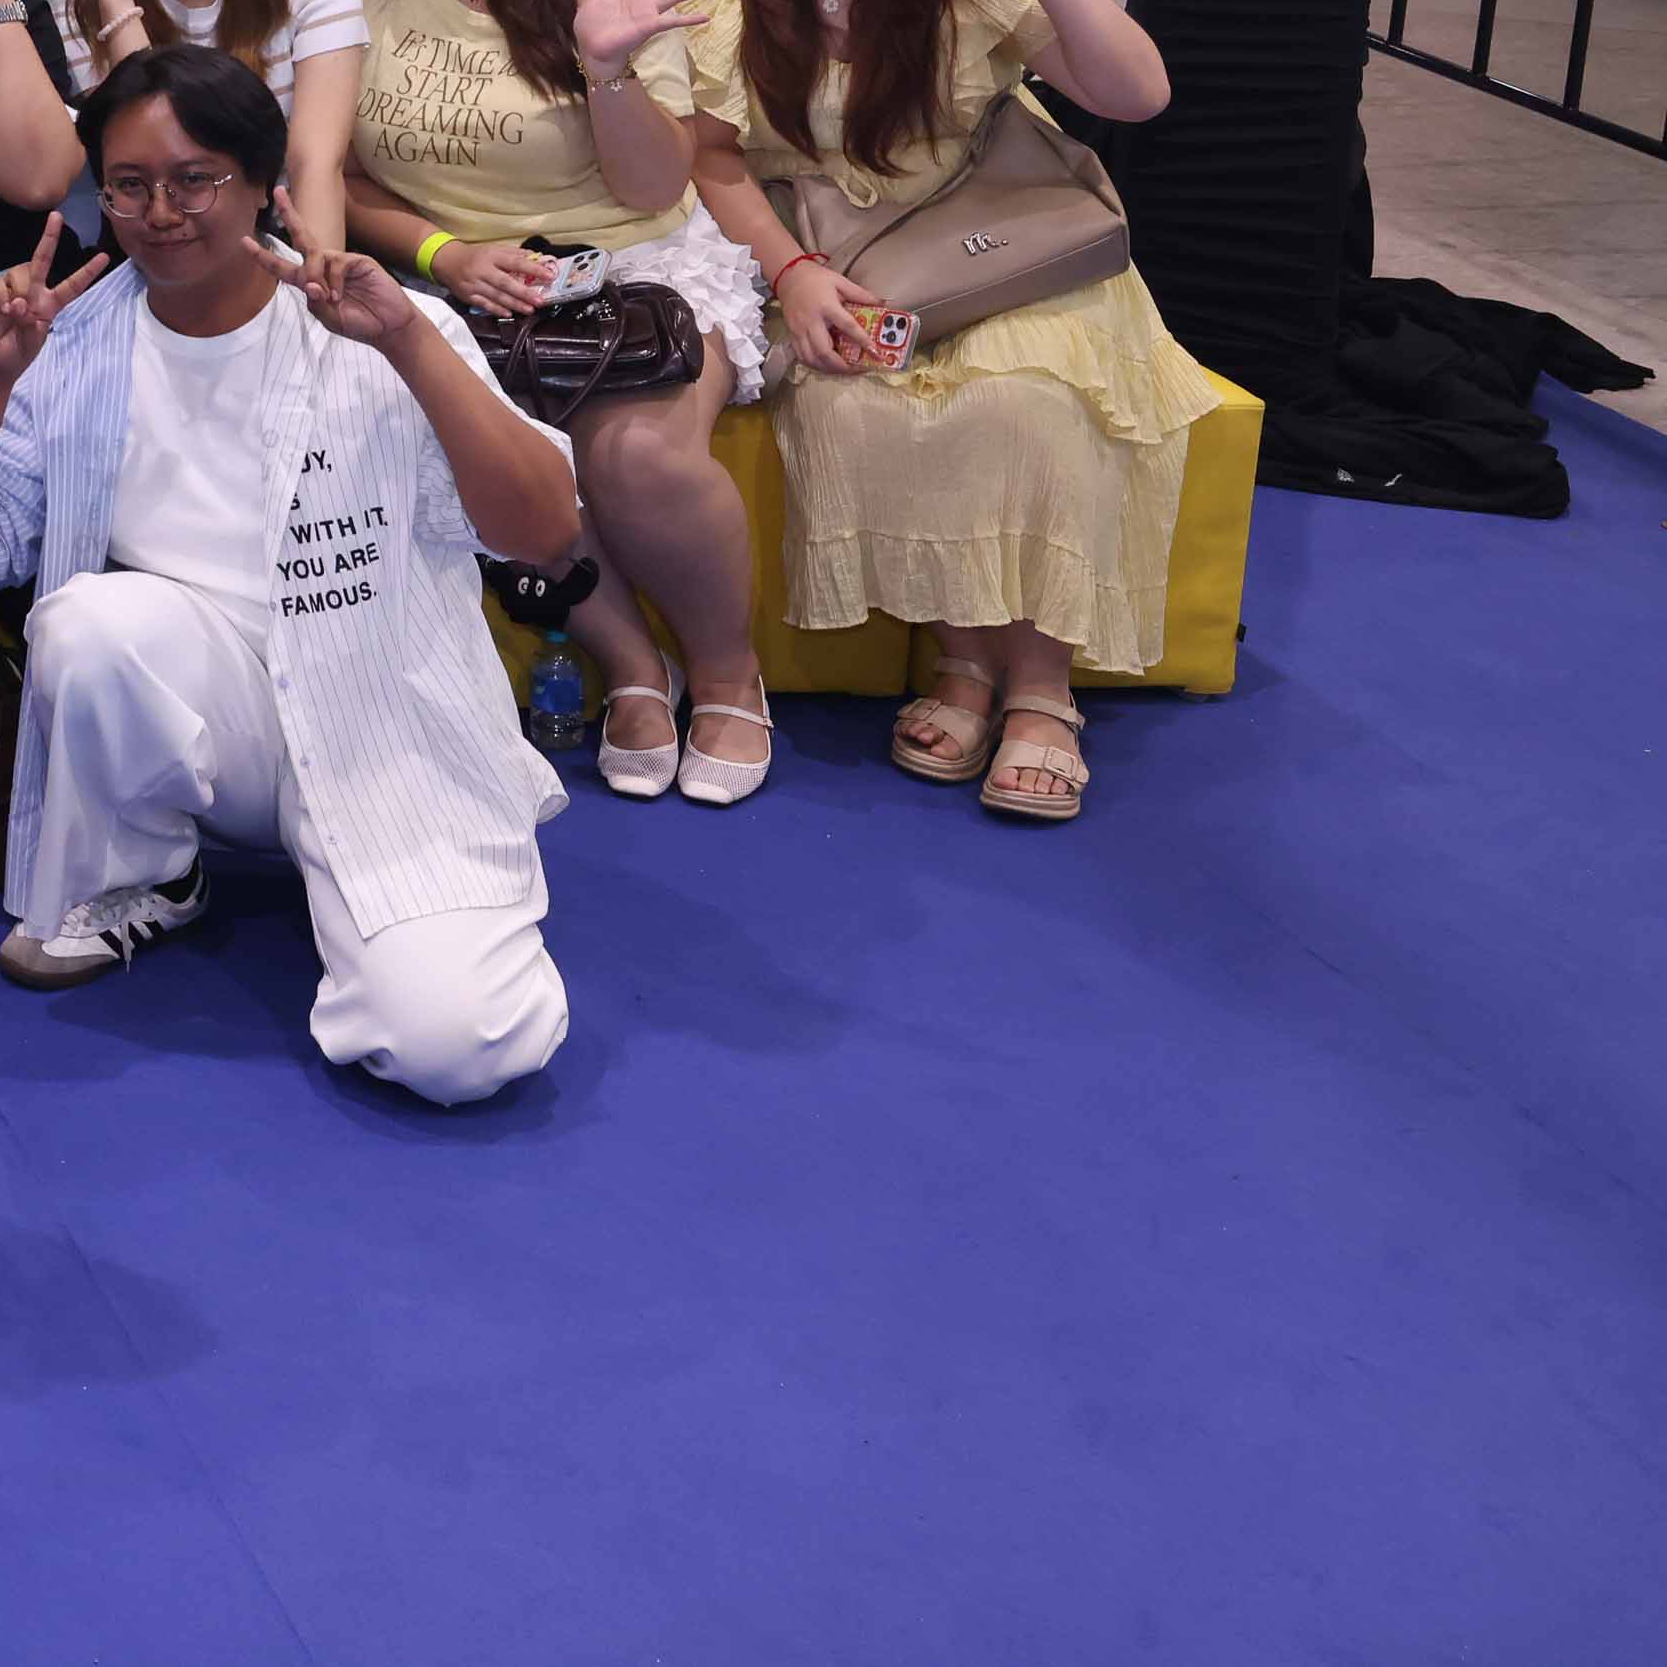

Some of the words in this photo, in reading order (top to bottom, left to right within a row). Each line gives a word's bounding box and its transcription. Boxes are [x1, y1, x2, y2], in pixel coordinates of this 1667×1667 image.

[427, 36, 501, 76] TIME
[395, 64, 494, 106] START
[355, 87, 525, 146] DREAMING
[373, 126, 482, 167] AGAIN
[289, 515, 357, 545] WITH
[276, 556, 326, 582] YOU
[334, 541, 380, 574] ARE
[280, 580, 378, 618] FAMOUS.
